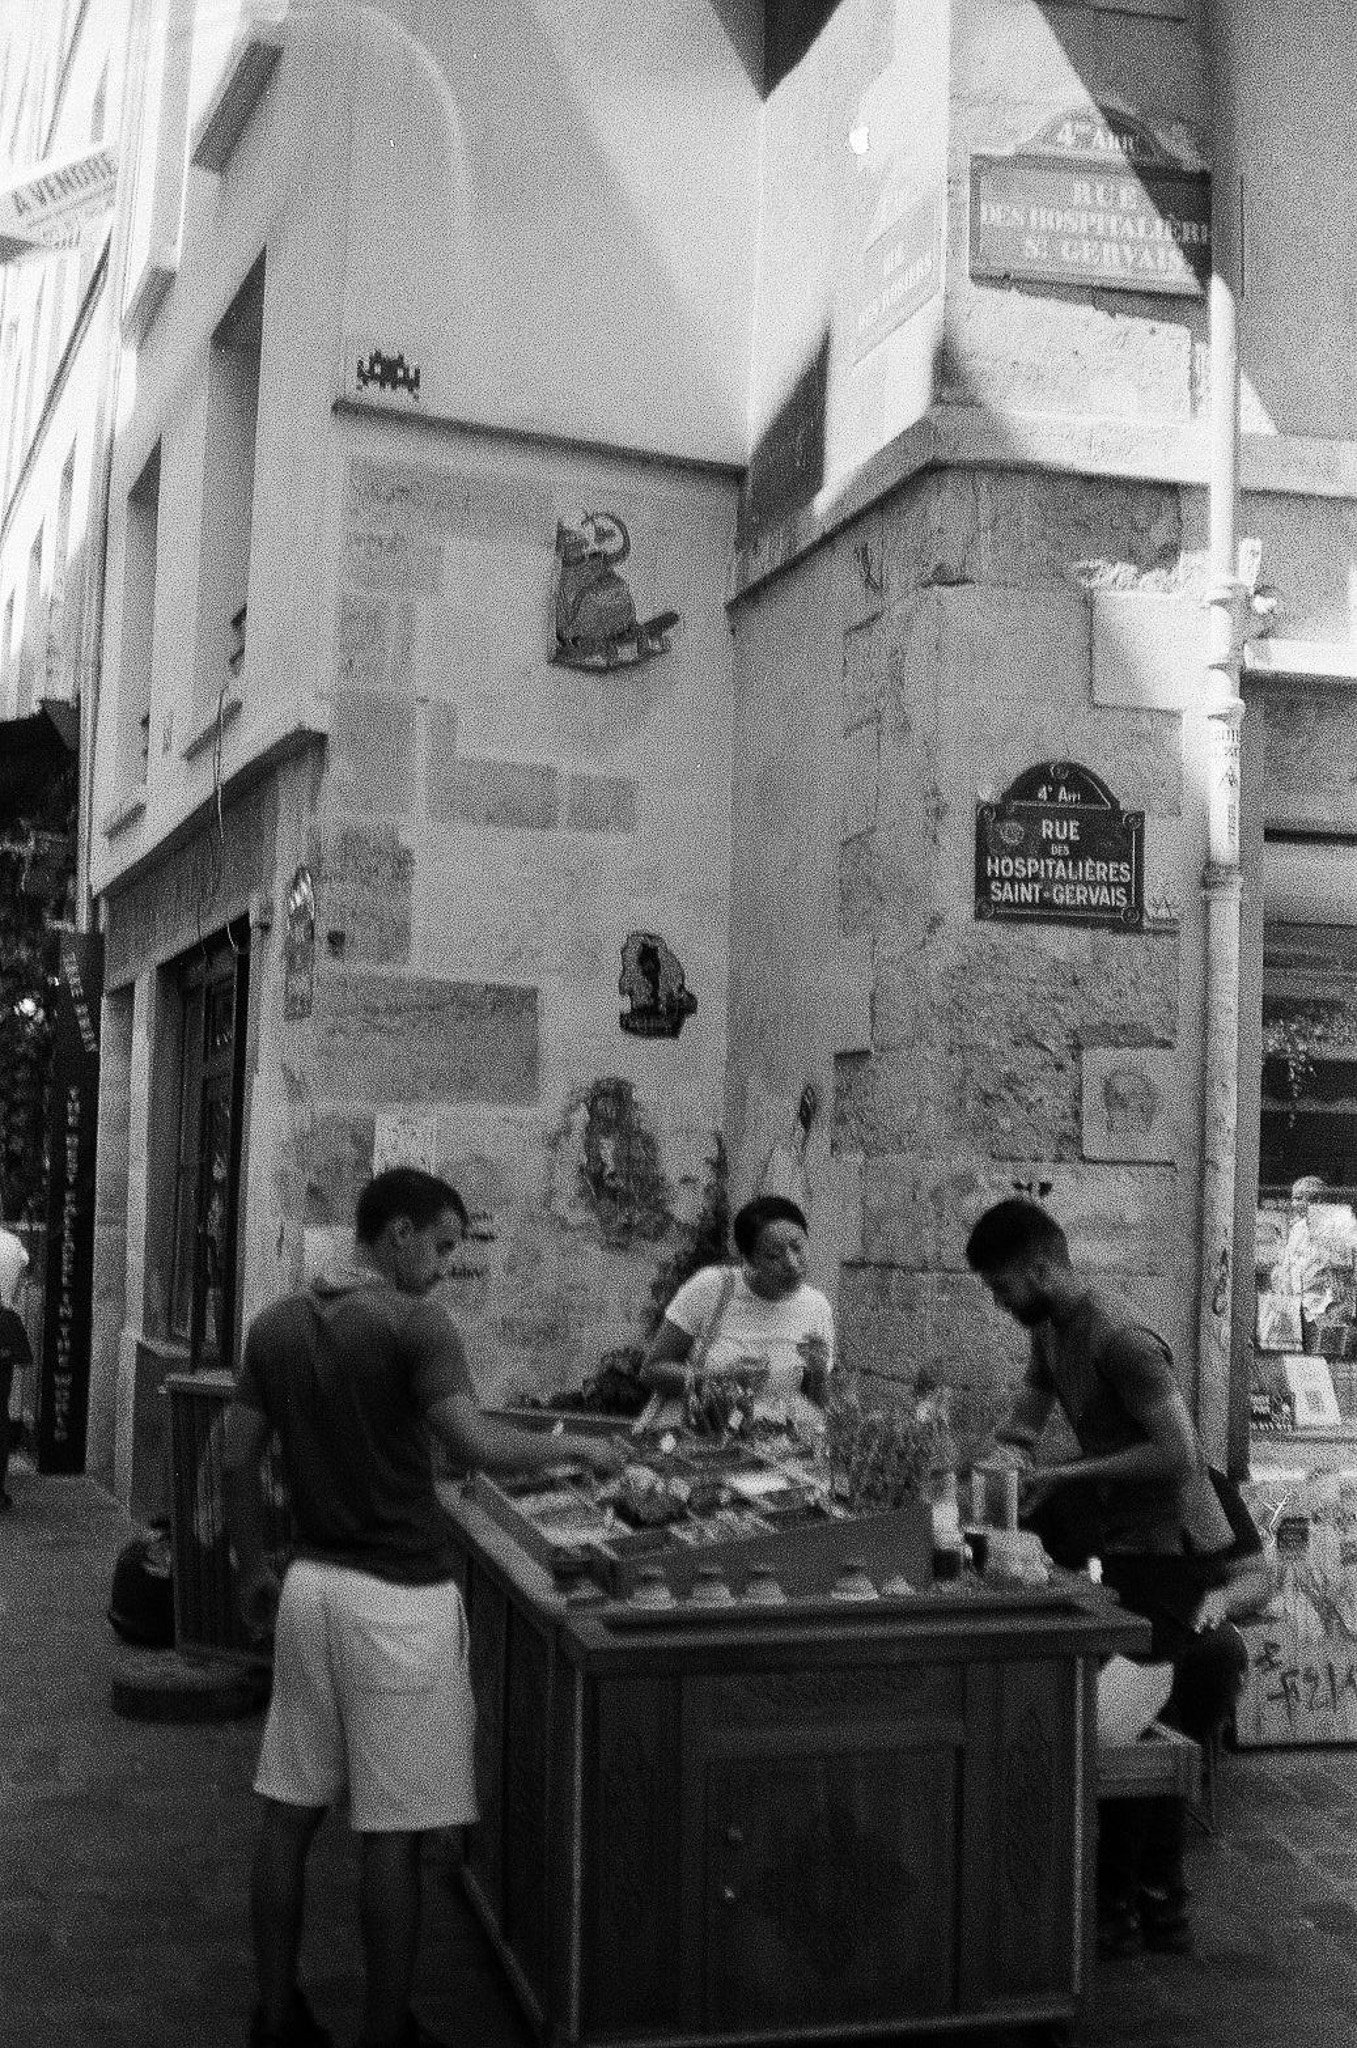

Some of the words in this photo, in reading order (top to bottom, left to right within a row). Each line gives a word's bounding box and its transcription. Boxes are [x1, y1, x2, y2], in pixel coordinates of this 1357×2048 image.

[1072, 179, 1138, 210] RUE
[981, 202, 1025, 227] DES
[1060, 238, 1189, 274] GERVAIS
[1041, 819, 1081, 841] RUE
[1050, 844, 1071, 857] DES
[986, 855, 1132, 883] HOSPITALIÈRES
[989, 881, 1128, 908] SAINT-GERVAIS
[65, 1085, 81, 1127] THE
[65, 1133, 80, 1186] BEST
[58, 1291, 73, 1319] IN
[56, 1324, 71, 1367] THE
[53, 1373, 73, 1443] WORLD
